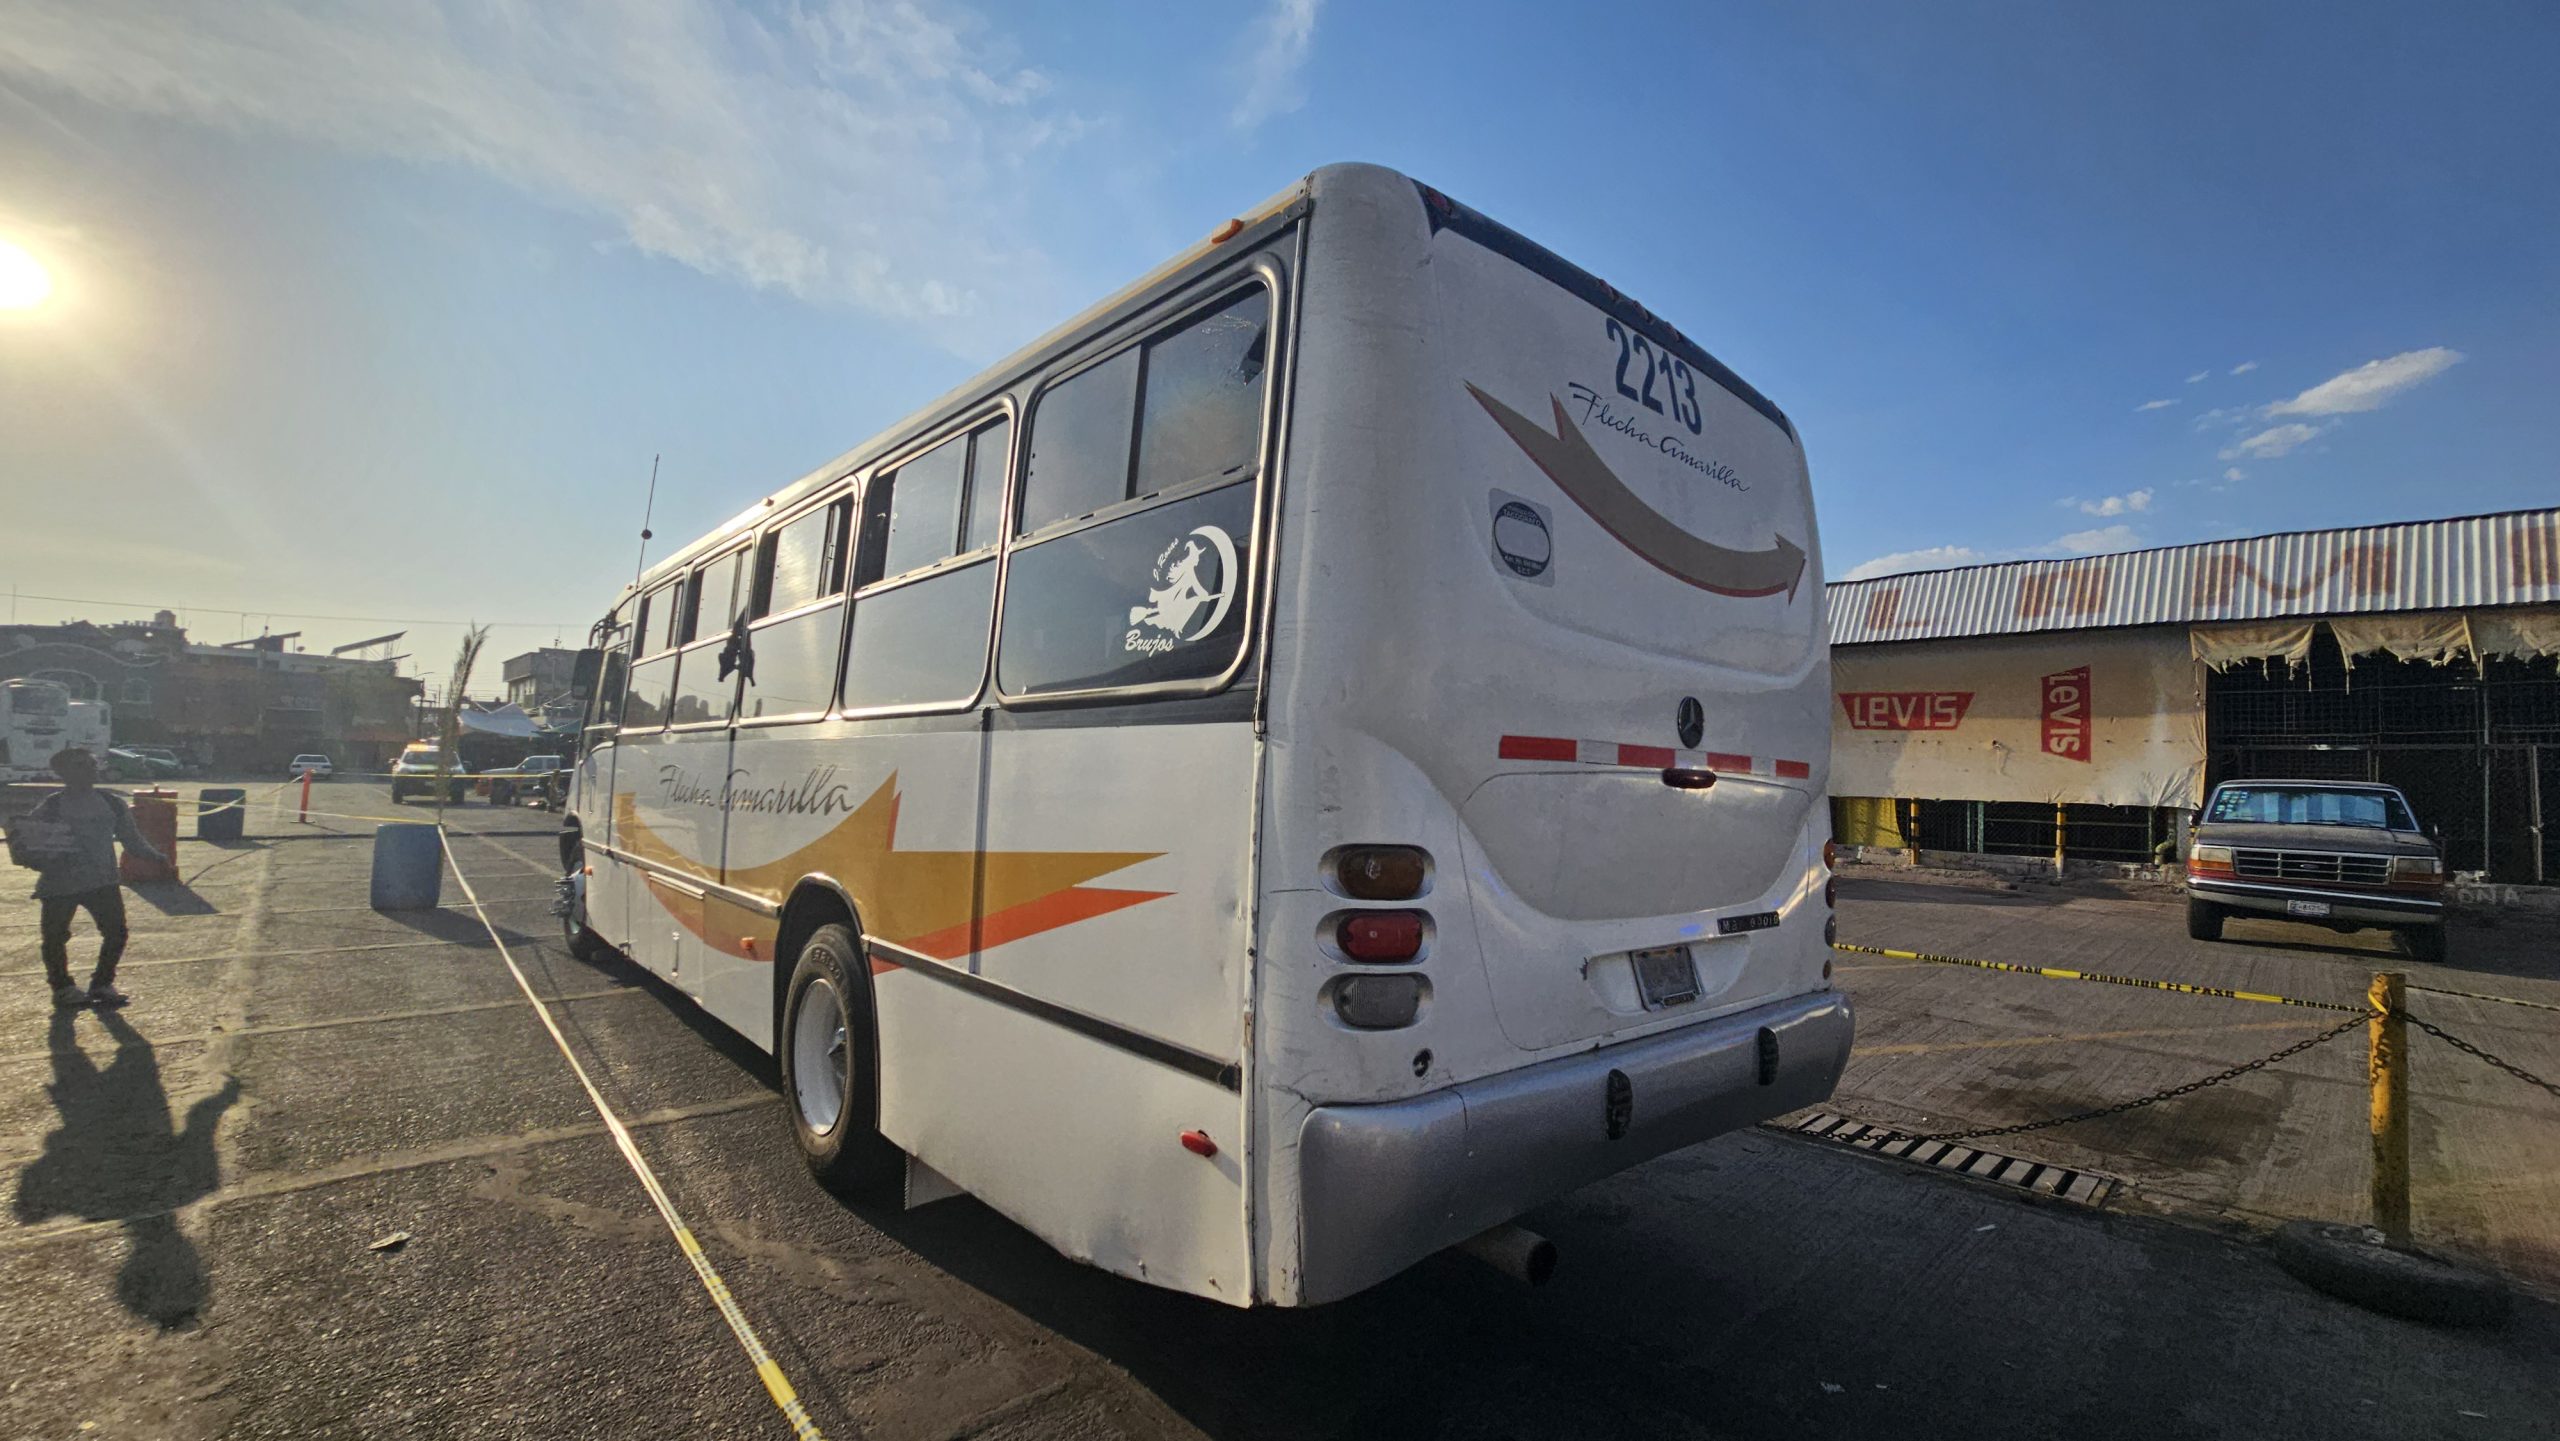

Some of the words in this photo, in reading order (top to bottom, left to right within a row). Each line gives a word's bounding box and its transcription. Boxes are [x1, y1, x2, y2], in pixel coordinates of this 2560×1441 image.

[1606, 317, 1702, 435] 2213
[1569, 381, 1659, 449] Flecha
[1125, 629, 1174, 658] Brujos
